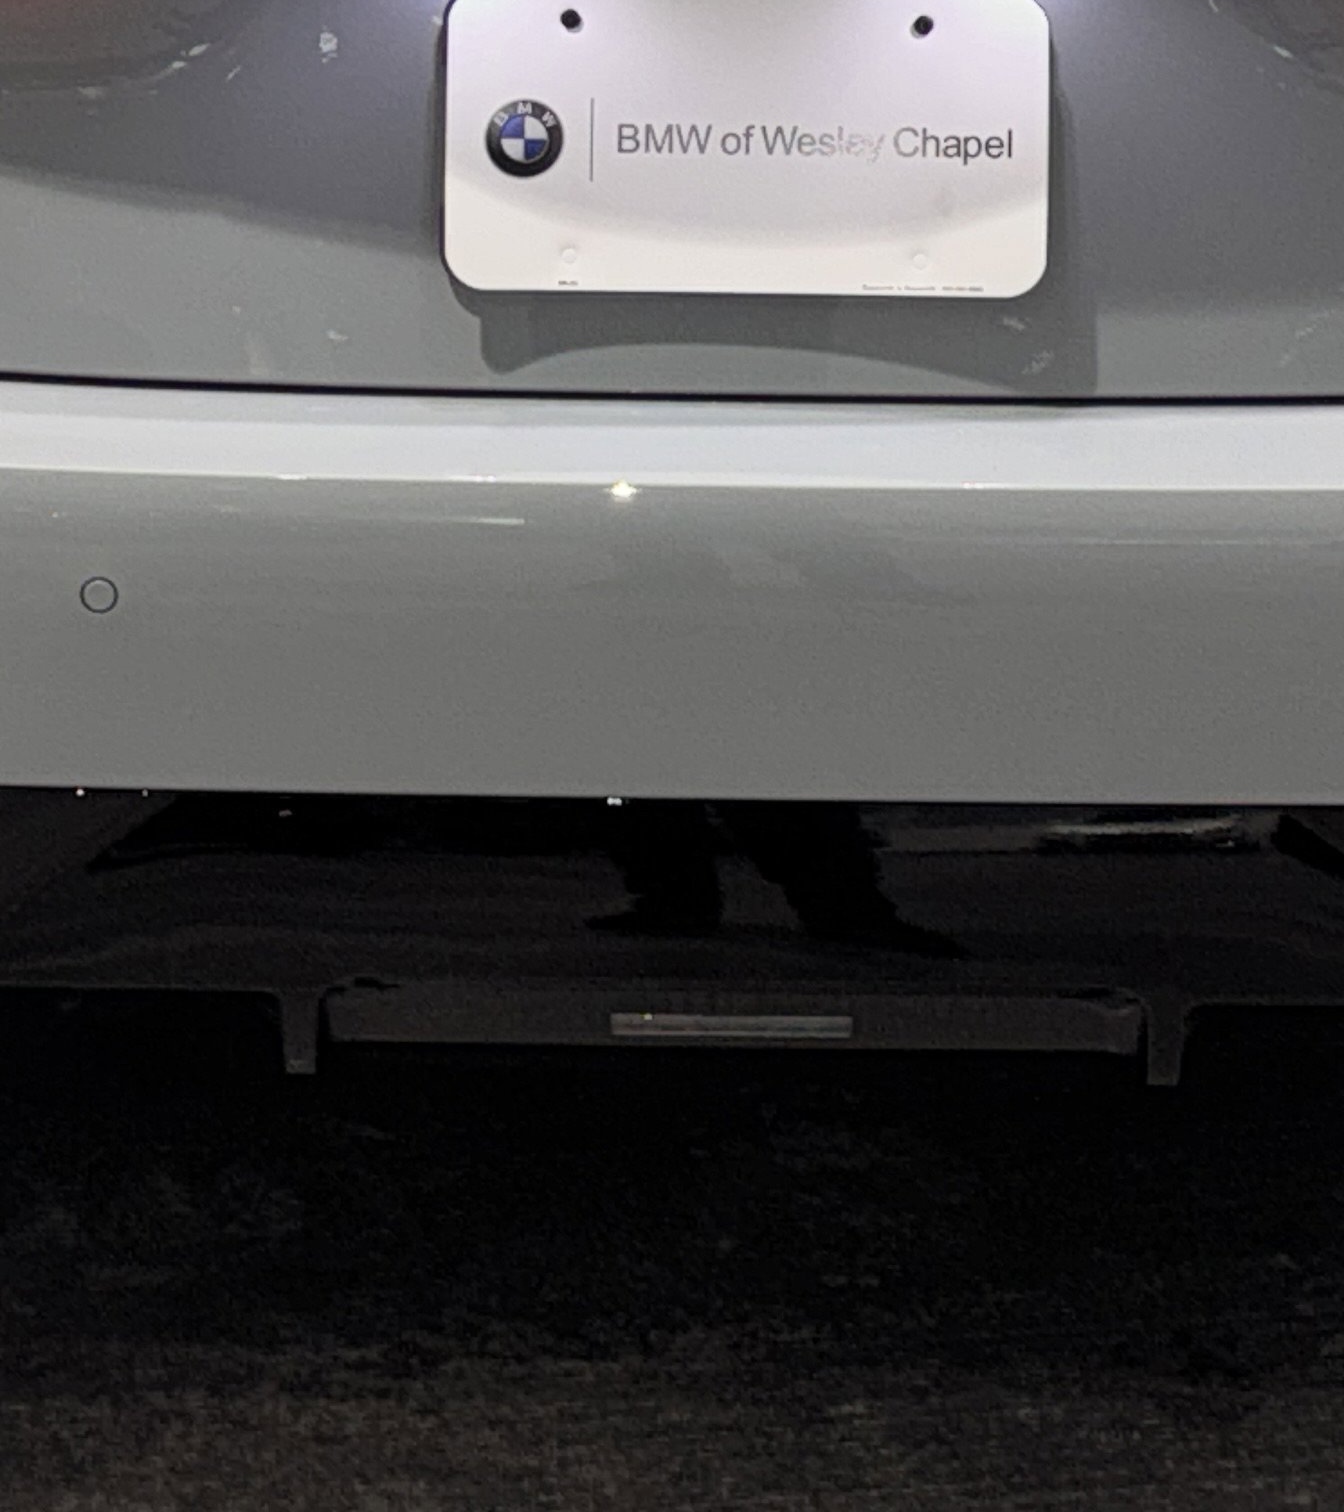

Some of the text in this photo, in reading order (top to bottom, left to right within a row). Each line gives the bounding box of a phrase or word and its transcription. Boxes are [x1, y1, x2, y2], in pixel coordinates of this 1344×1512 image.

[616, 123, 1013, 166] BMW of Wesley Chapel
